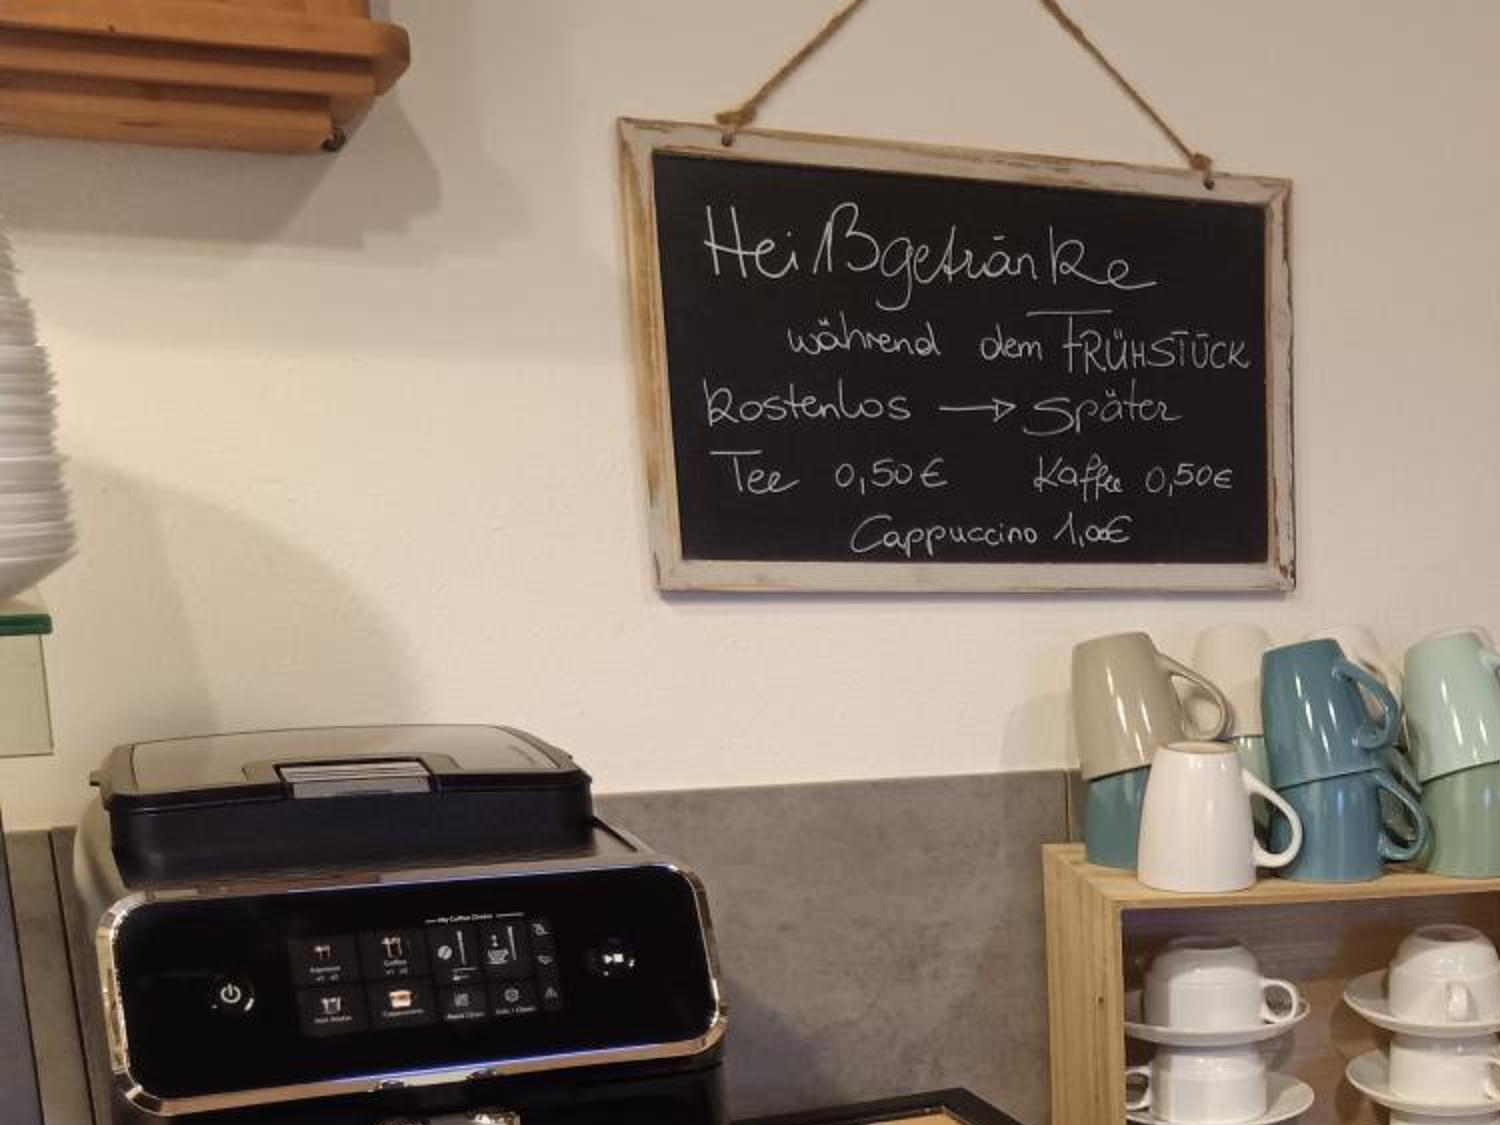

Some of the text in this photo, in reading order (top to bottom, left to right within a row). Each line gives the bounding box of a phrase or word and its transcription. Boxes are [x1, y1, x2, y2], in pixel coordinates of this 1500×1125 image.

[786, 308, 1251, 375] während dem FRÜHSTÜCK
[709, 448, 800, 495] Tee
[834, 456, 949, 496] 0,50€
[1145, 462, 1233, 497] 0,50€
[850, 513, 1038, 558] Cappuccino
